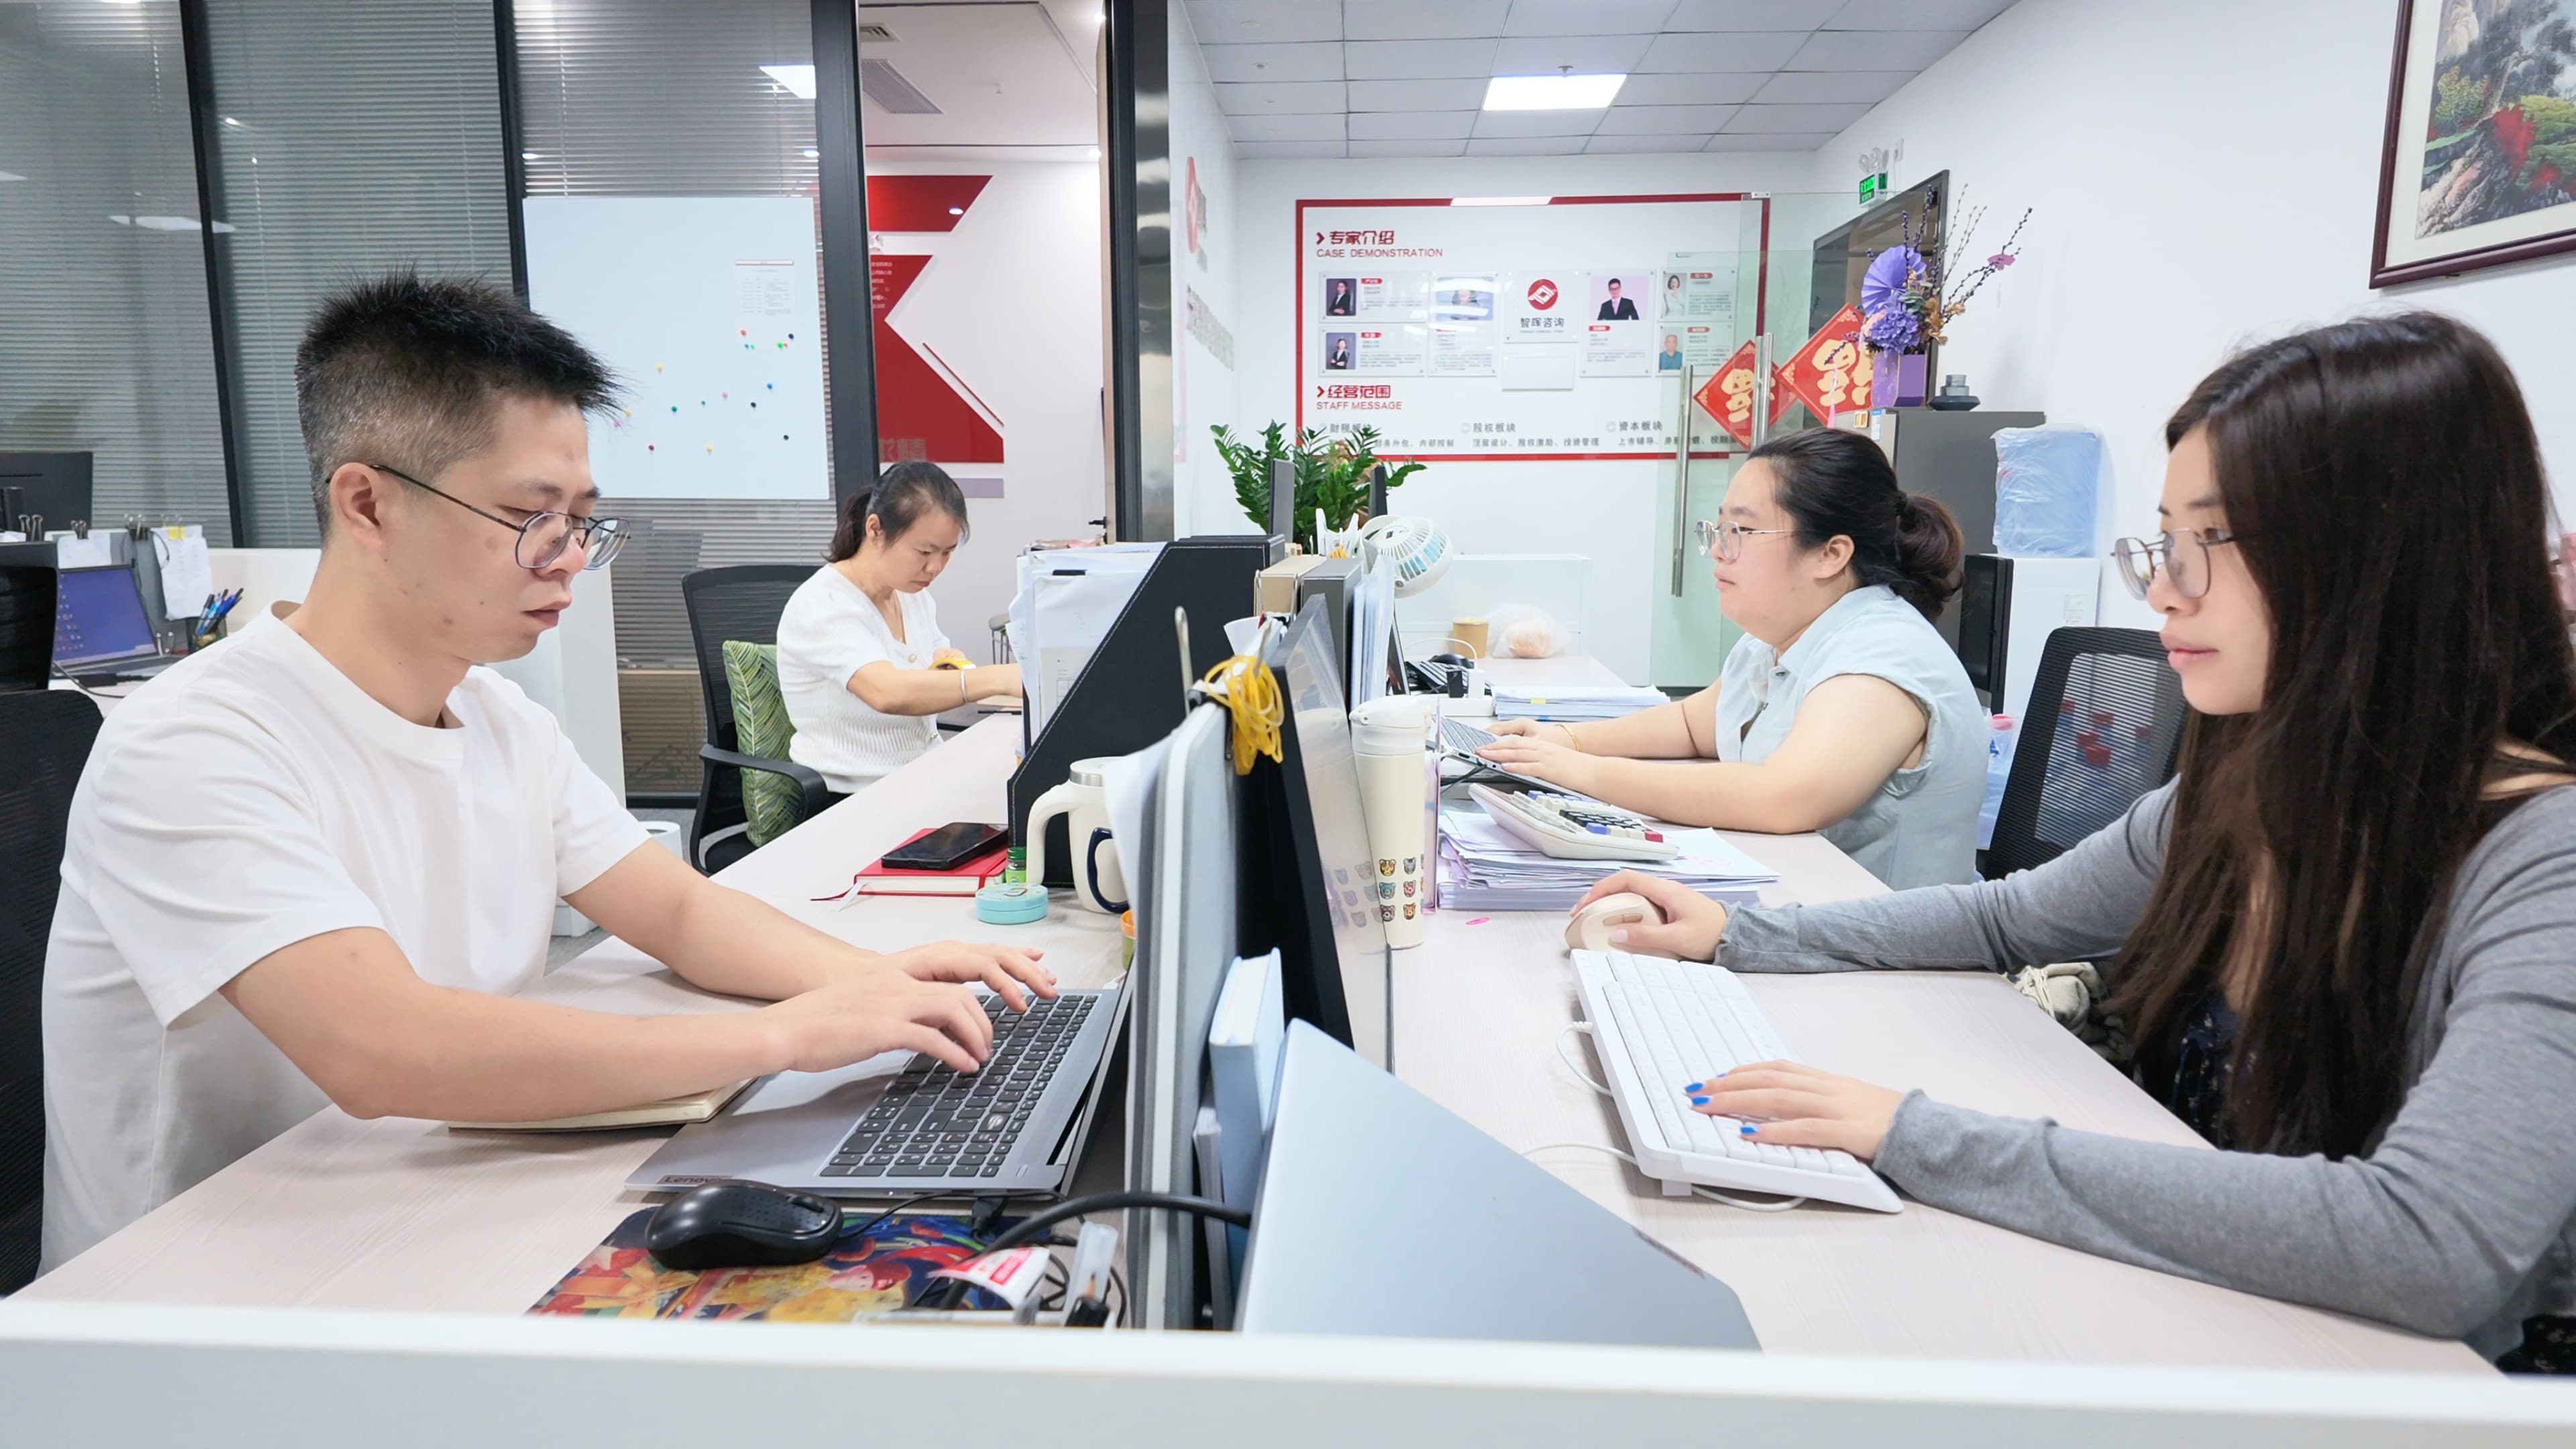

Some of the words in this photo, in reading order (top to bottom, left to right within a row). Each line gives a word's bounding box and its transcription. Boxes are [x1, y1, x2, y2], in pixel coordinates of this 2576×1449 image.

[1329, 230, 1395, 245] 专家介绍
[1317, 249, 1345, 258] CASE
[1350, 248, 1443, 258] DEMONSTRATION
[1328, 384, 1391, 398] 经营范围
[1317, 401, 1348, 410] STAFF
[1352, 400, 1403, 410] MESSAGE
[1473, 423, 1516, 433] 股权板块
